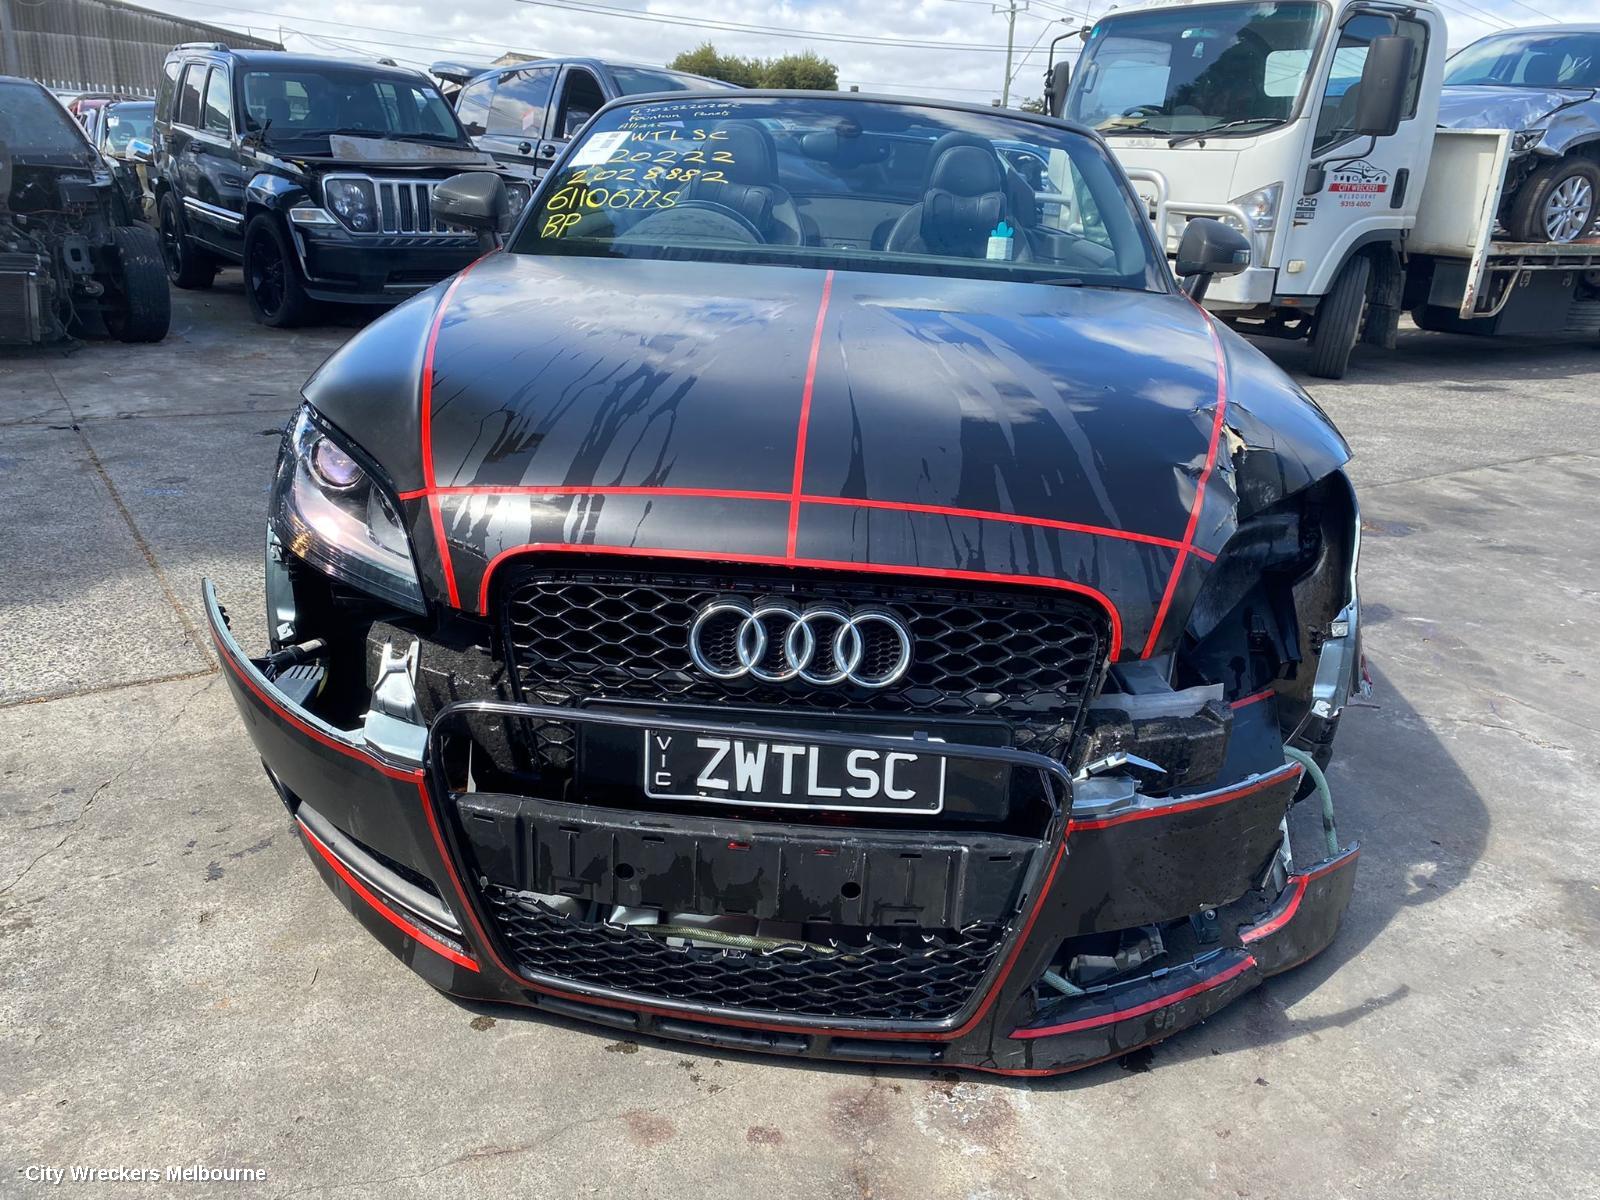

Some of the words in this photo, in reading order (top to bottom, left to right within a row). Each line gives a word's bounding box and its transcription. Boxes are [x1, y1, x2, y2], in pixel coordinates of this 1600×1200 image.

[1297, 197, 1318, 207] 450
[541, 213, 582, 238] BP
[655, 736, 673, 787] VIC
[696, 737, 919, 801] ZWTLSC
